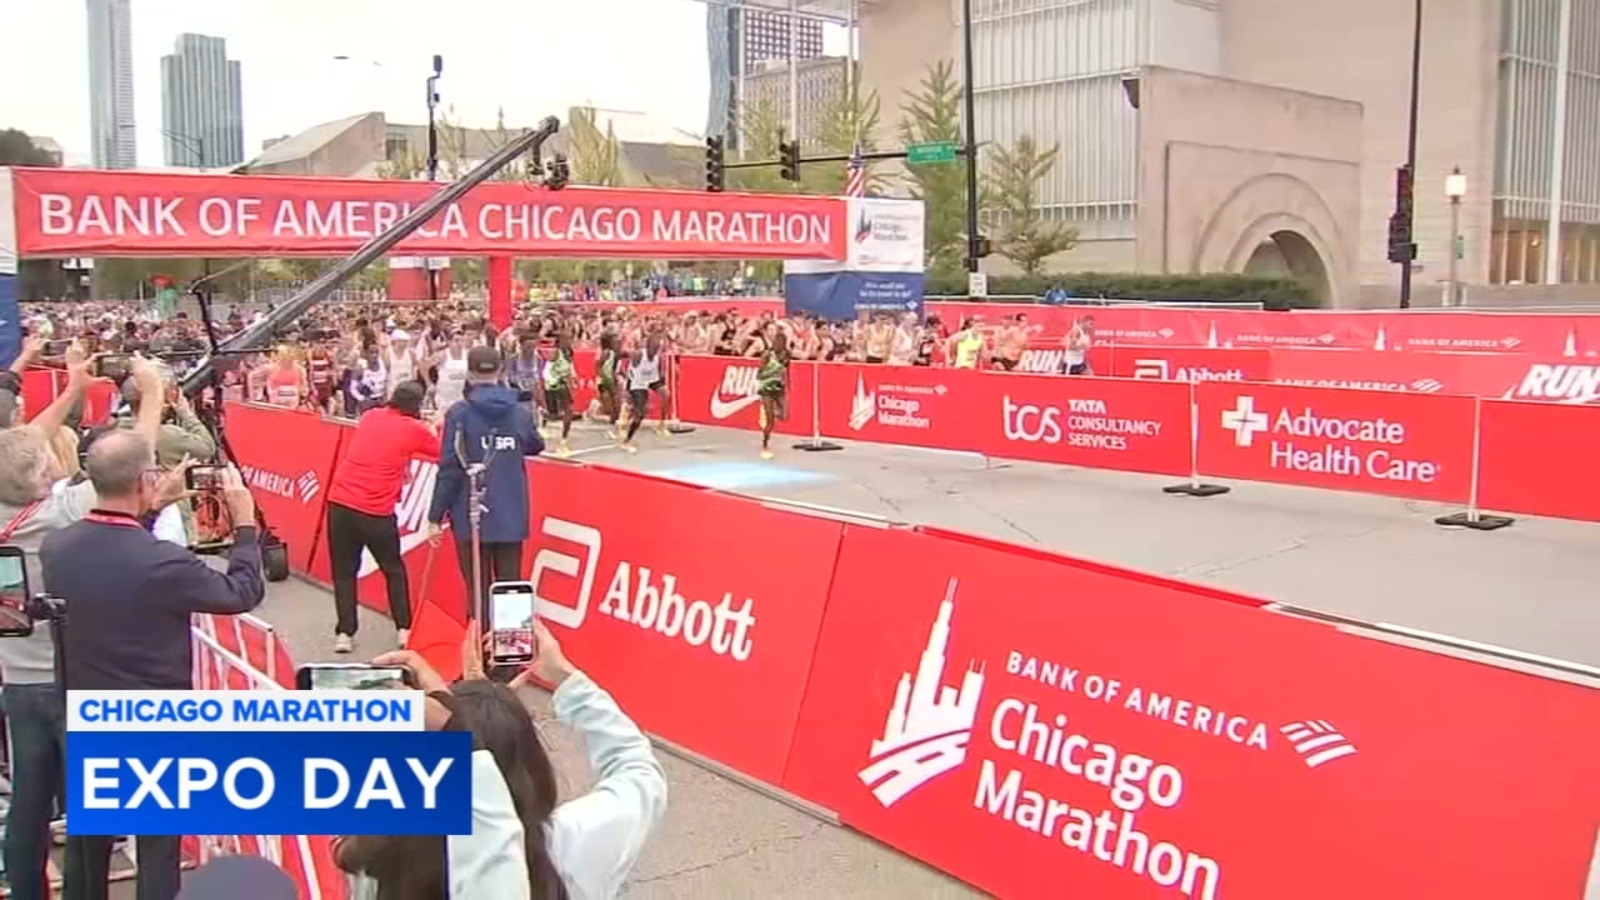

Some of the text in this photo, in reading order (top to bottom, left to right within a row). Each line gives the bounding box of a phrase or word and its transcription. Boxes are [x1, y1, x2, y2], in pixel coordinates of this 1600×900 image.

[40, 194, 186, 236] BANK
[199, 197, 261, 236] OF
[478, 203, 641, 240] CHICAGO
[653, 209, 831, 244] MARATHON
[878, 394, 920, 417] Chicago
[878, 410, 931, 430] Marathon
[1003, 395, 1061, 443] tcs
[1068, 399, 1106, 415] TATA
[481, 436, 516, 450] USA
[1068, 415, 1162, 437] CONSULTANCY
[1068, 432, 1127, 450] SERVICES
[1273, 407, 1405, 444] Advocate
[1270, 440, 1436, 483] Health Care
[251, 469, 296, 499] AMERICA
[598, 560, 756, 661] Abbott
[1006, 650, 1269, 751] BANK OF AMERICA
[990, 698, 1183, 812] Chicago
[973, 759, 1221, 900] Marathon
